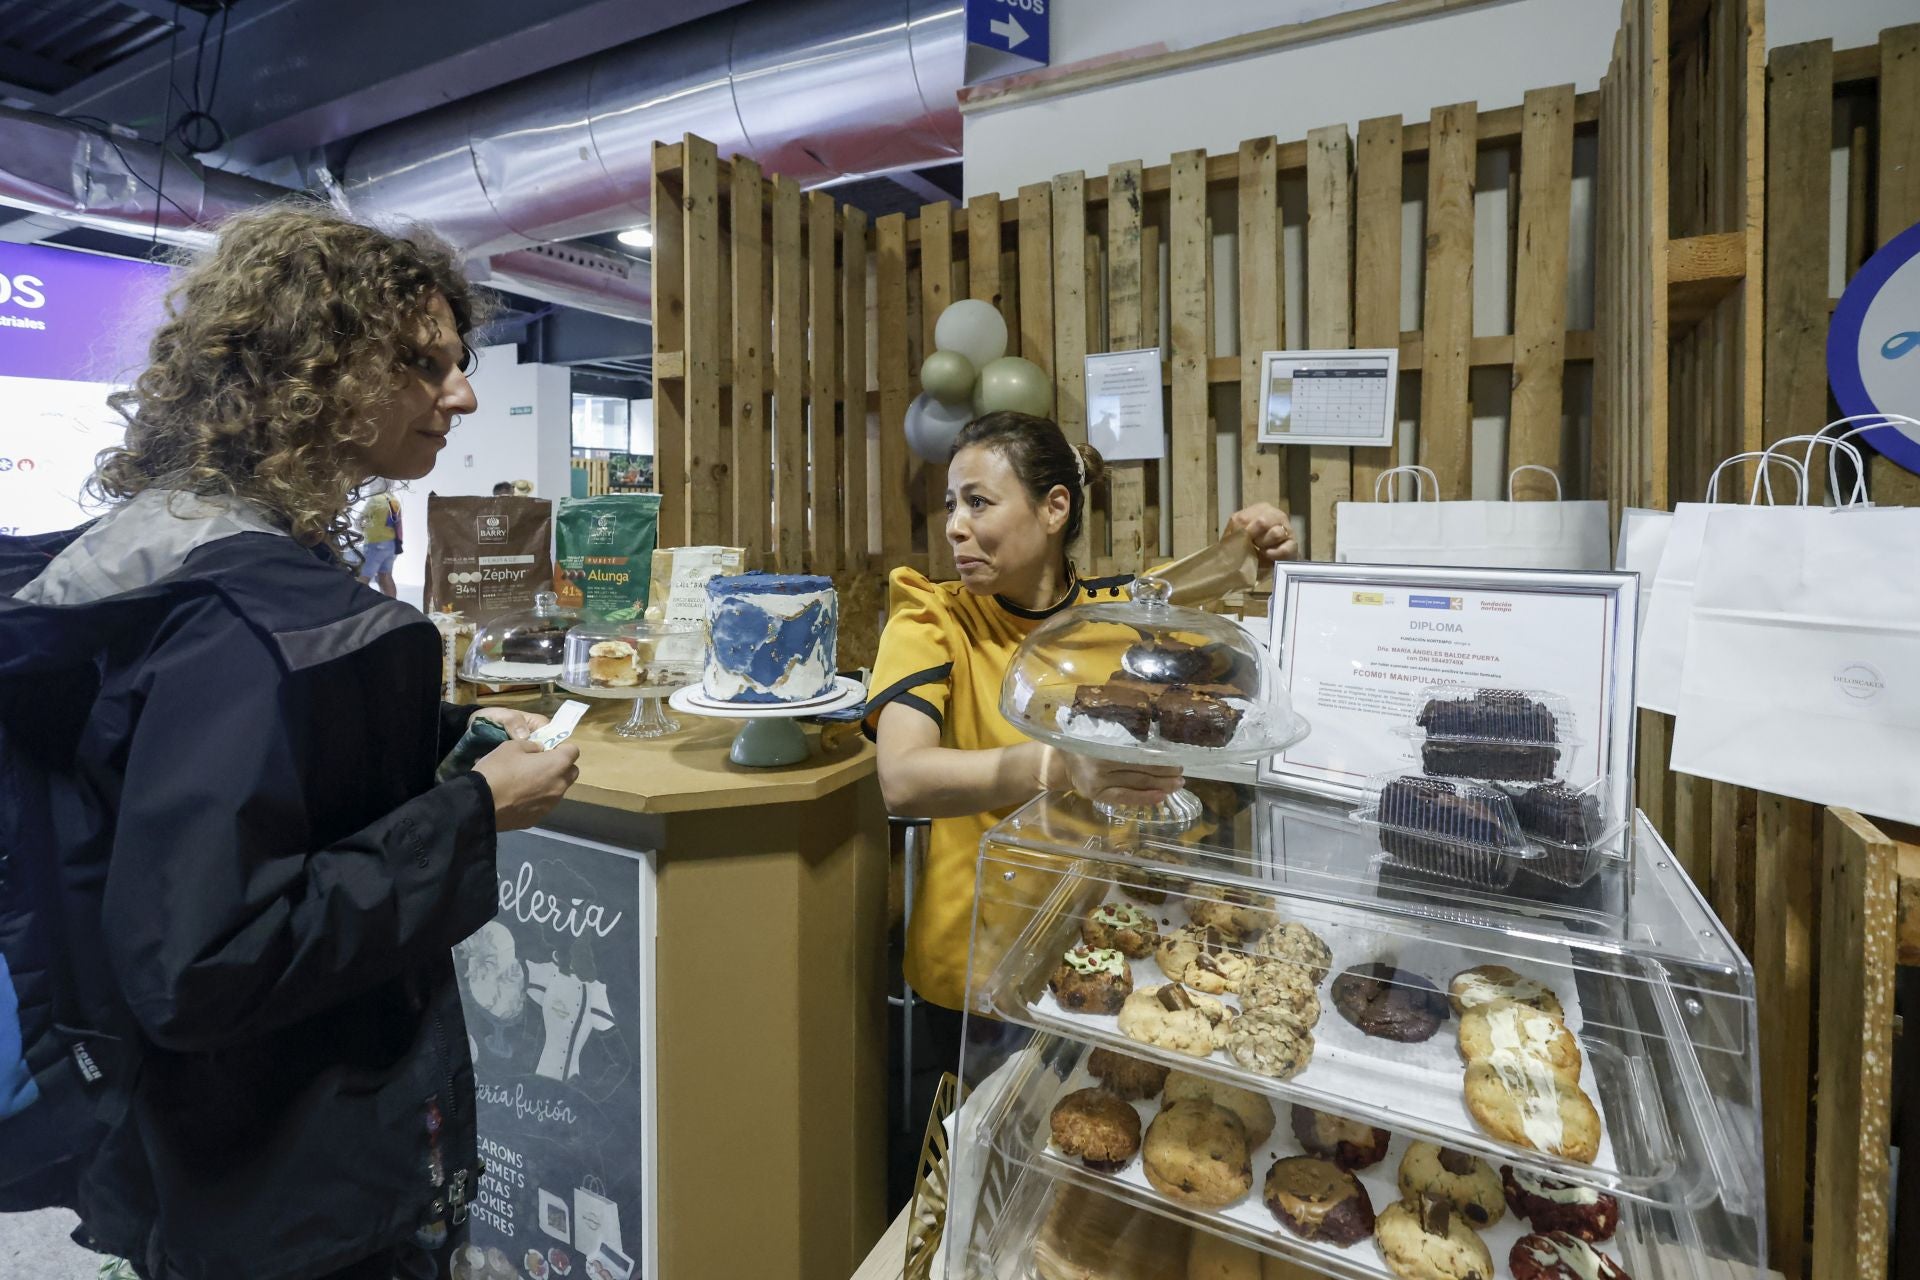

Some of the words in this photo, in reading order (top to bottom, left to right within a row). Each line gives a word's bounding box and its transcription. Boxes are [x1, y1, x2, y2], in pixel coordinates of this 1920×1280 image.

[483, 568, 526, 581] Zéphyr
[588, 569, 629, 585] Alunga
[456, 584, 477, 594] 34%
[1410, 620, 1463, 633] DIPLOMA
[1471, 654, 1500, 662] PUERTA
[1353, 669, 1387, 679] FCOM01
[496, 861, 622, 937] elería
[516, 1083, 577, 1124] fusión
[478, 1174, 510, 1199] RTAS
[478, 1190, 514, 1219] OKIES
